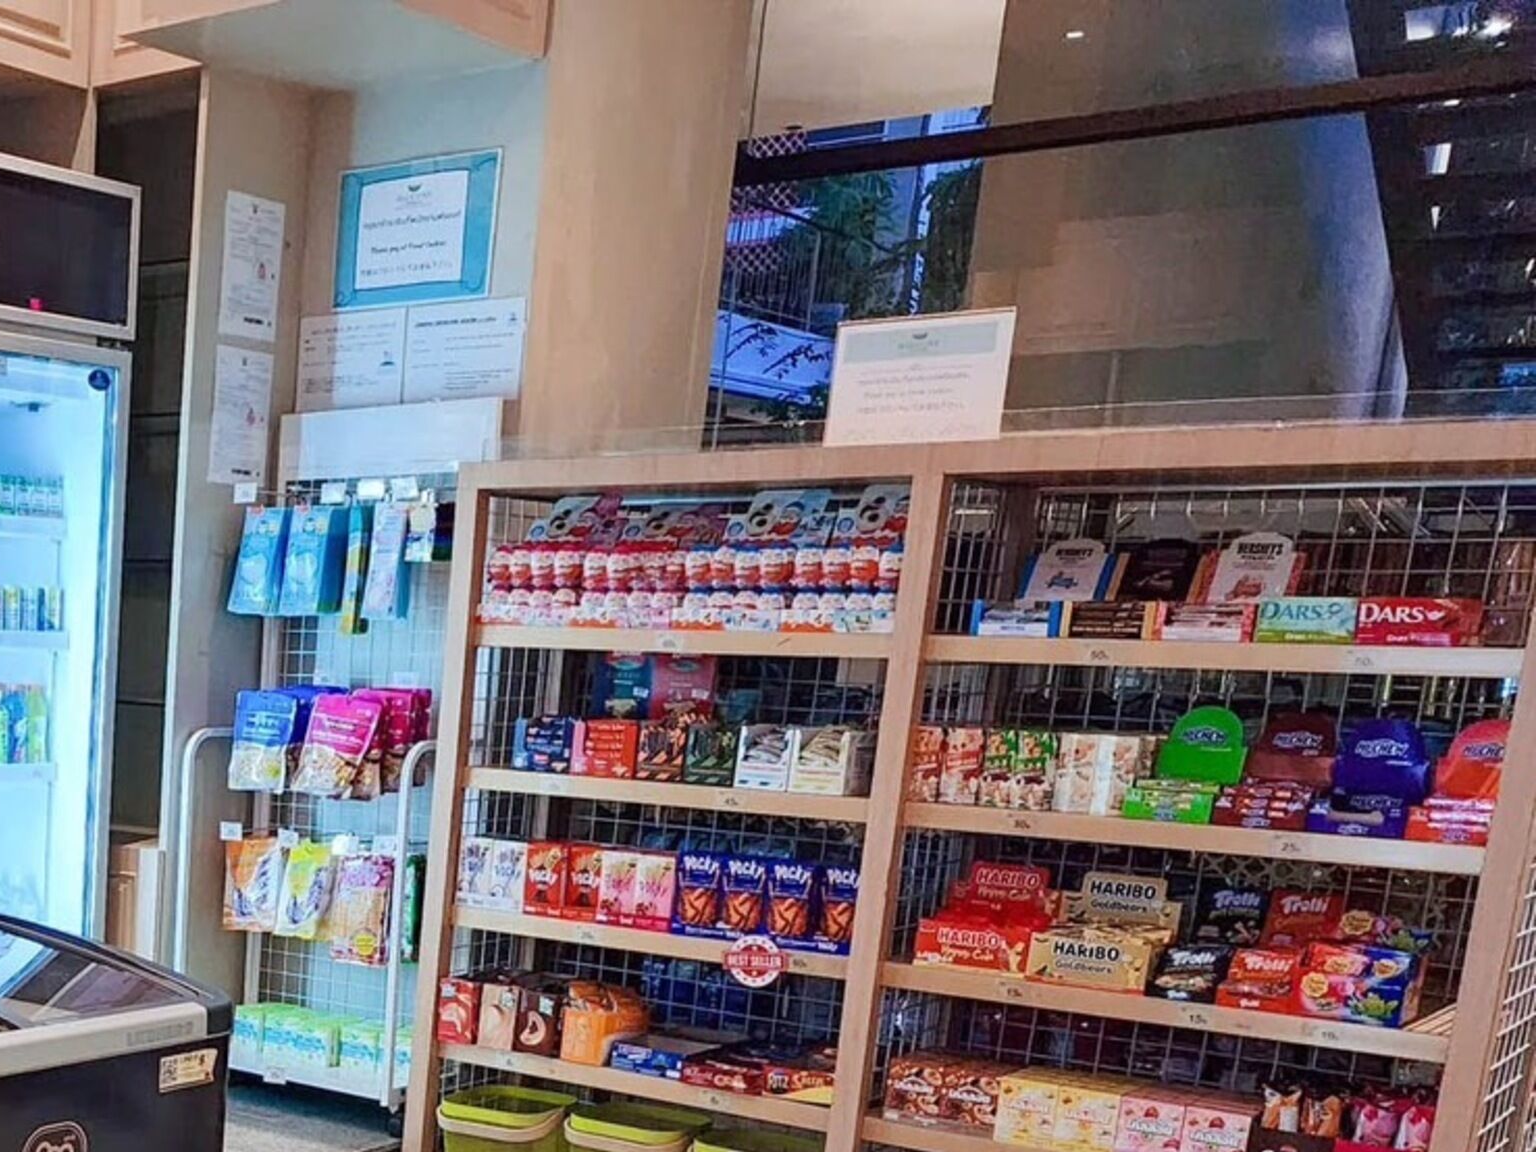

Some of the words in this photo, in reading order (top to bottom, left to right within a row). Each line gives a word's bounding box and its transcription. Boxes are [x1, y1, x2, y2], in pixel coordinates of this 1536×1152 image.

[1261, 601, 1324, 622] DARS
[1359, 602, 1426, 624] DARS
[975, 867, 1041, 888] HARIBO
[1089, 879, 1157, 901] HARIBO
[1280, 895, 1330, 915] Trolli
[937, 926, 1002, 950] HARIBO
[726, 954, 749, 968] BEST
[750, 955, 783, 968] SELLER
[1052, 939, 1121, 963] HARIBO
[1242, 951, 1292, 973] Trolli
